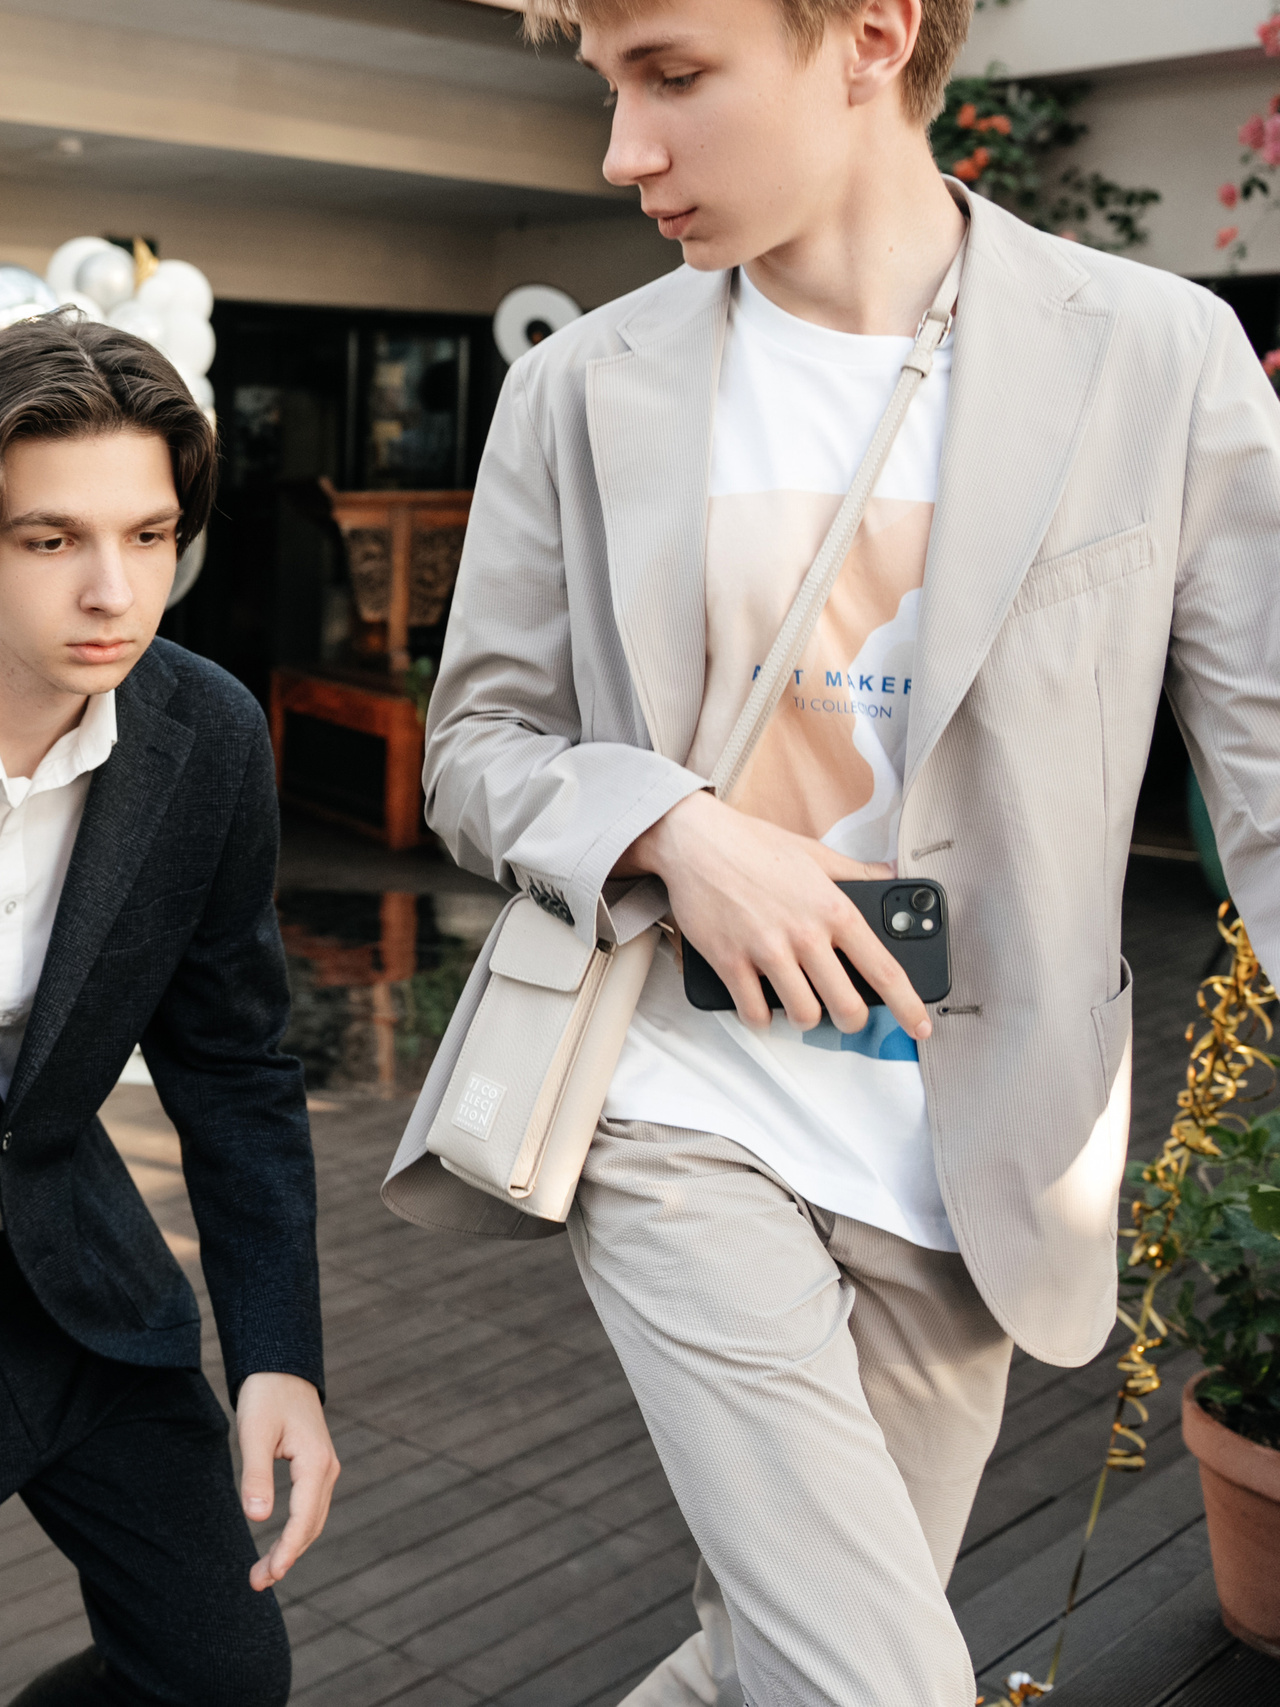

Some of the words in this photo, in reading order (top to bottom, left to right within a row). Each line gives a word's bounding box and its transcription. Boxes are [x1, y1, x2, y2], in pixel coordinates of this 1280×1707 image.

[751, 664, 804, 686] AT
[794, 696, 805, 711] TJ
[810, 698, 893, 719] COLLECION
[469, 1077, 480, 1091] TJ
[481, 1084, 498, 1099] CO
[459, 1102, 493, 1127] TION
